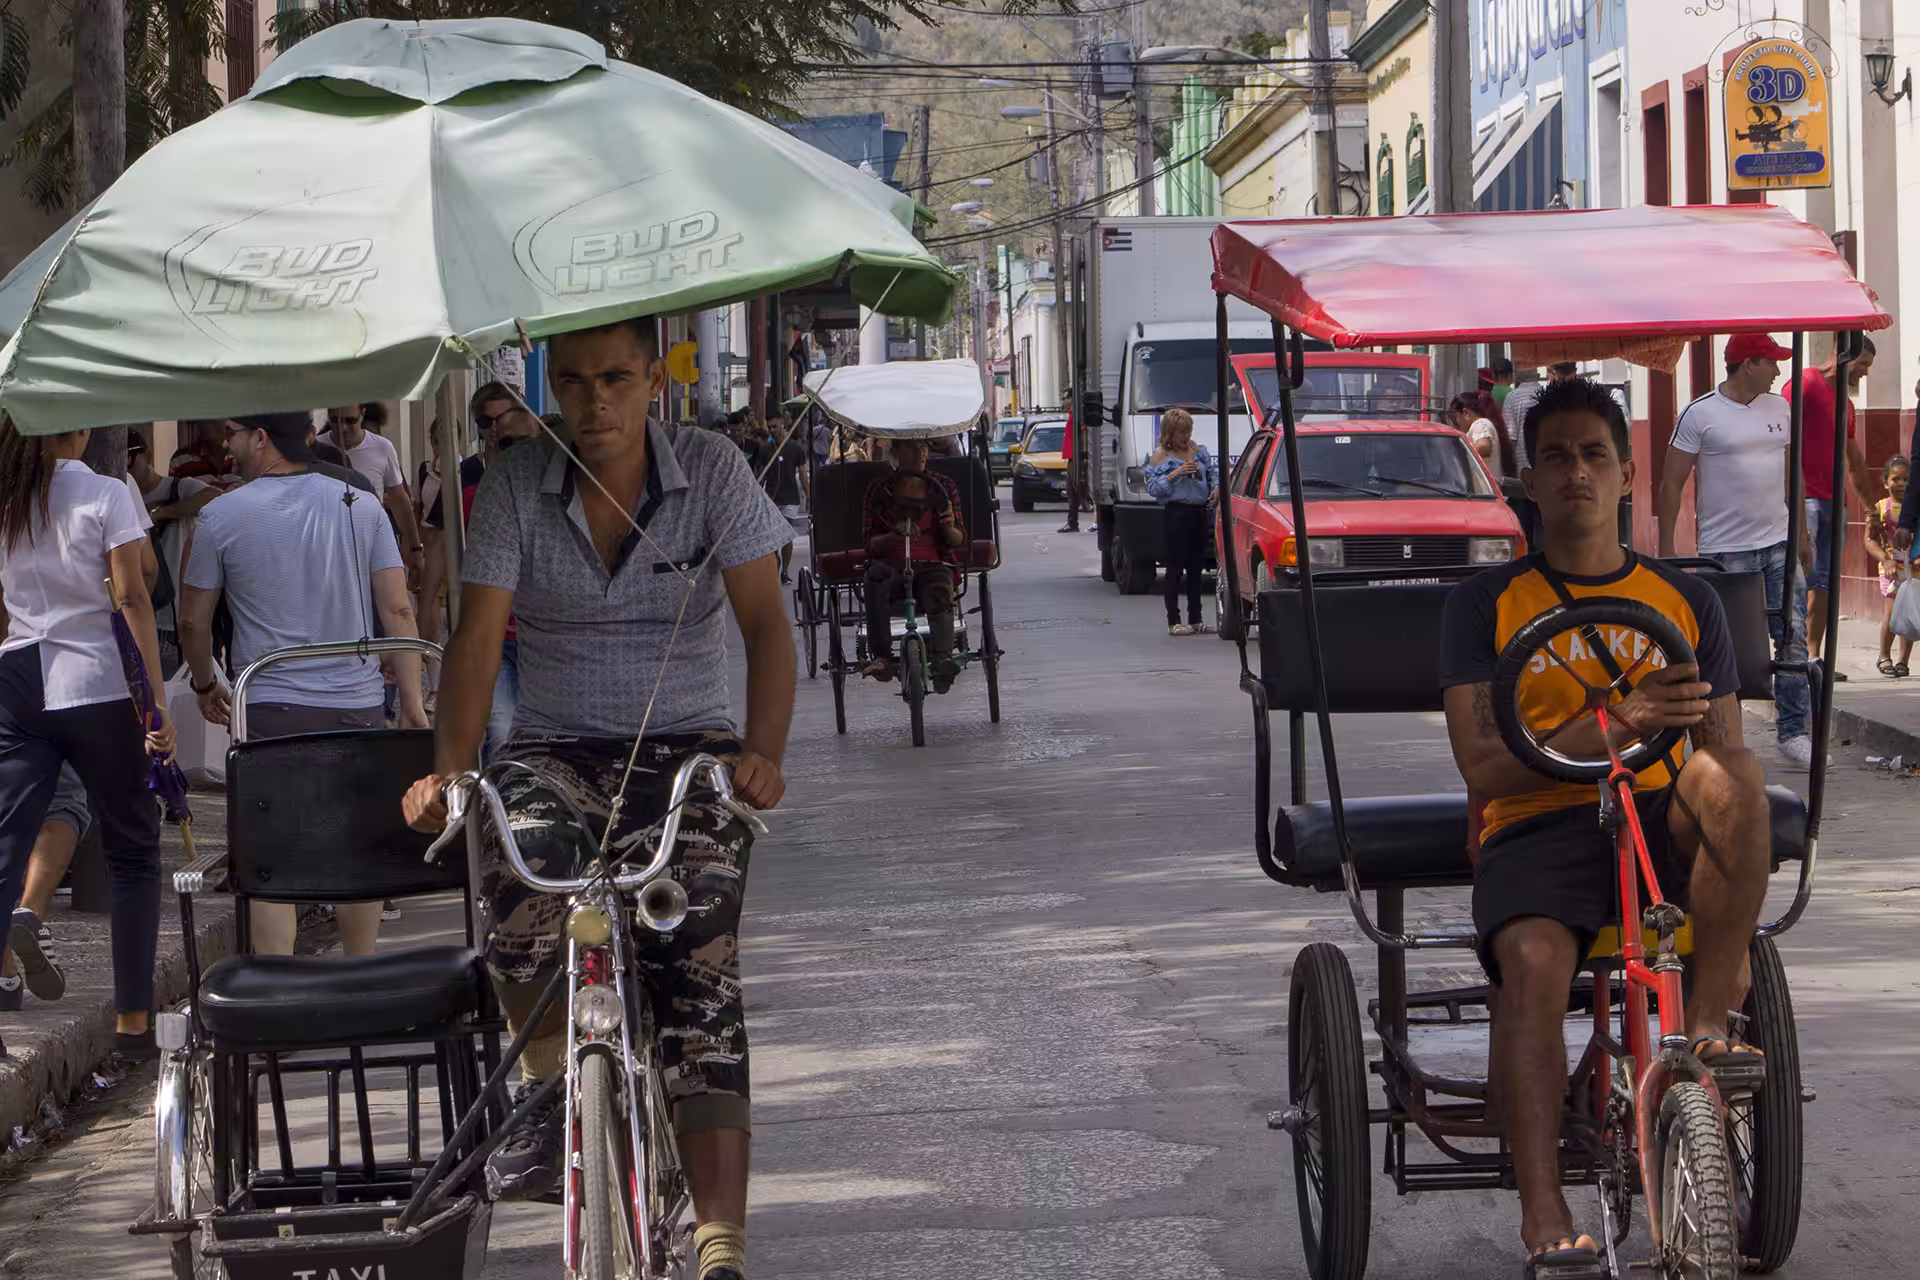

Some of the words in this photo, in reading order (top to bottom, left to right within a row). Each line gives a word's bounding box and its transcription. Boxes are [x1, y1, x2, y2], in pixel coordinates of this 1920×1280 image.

[1734, 46, 1771, 81] PROYECTO
[1773, 45, 1794, 55] CINE
[1747, 65, 1806, 104] 3D
[218, 238, 374, 278] BUD
[571, 211, 720, 265] BUD
[554, 232, 744, 296] LIGHT
[190, 268, 379, 315] LIGHT
[1529, 629, 1668, 673] SLAKER
